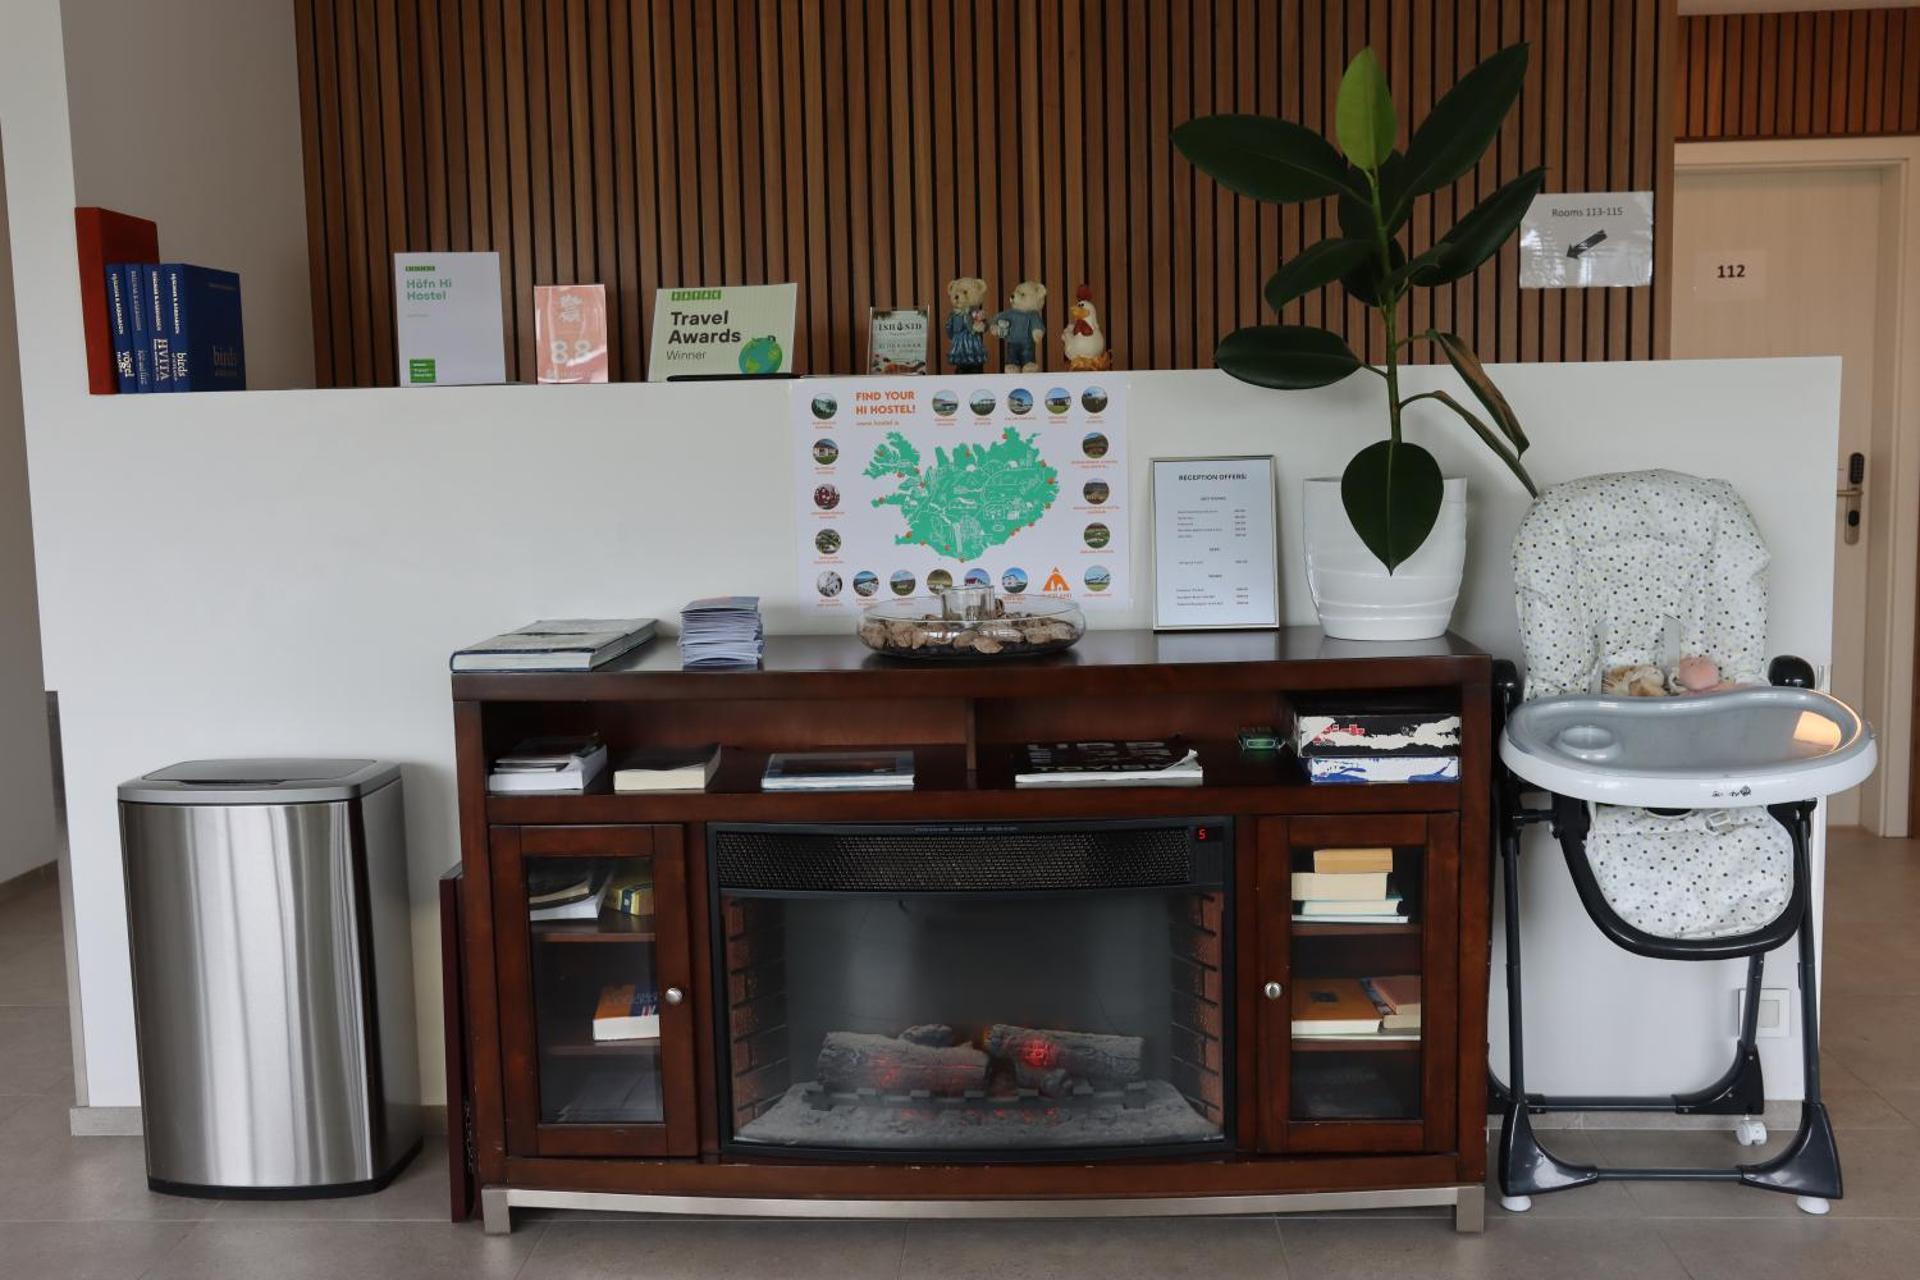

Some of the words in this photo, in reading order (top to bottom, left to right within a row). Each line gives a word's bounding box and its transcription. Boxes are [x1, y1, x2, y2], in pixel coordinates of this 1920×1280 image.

[1551, 208, 1583, 217] Rooms
[1586, 207, 1623, 217] 113-115
[1716, 264, 1746, 279] 112
[406, 278, 436, 289] Höfn
[439, 278, 452, 288] Hi
[407, 290, 447, 301] Hostel
[670, 310, 729, 326] Travel
[668, 328, 742, 344] Awards
[666, 350, 707, 361] Winner
[176, 352, 188, 377] birds
[856, 392, 881, 401] FIND
[884, 391, 915, 400] YOUR
[856, 405, 867, 415] HI
[870, 404, 916, 415] HOSTEL!
